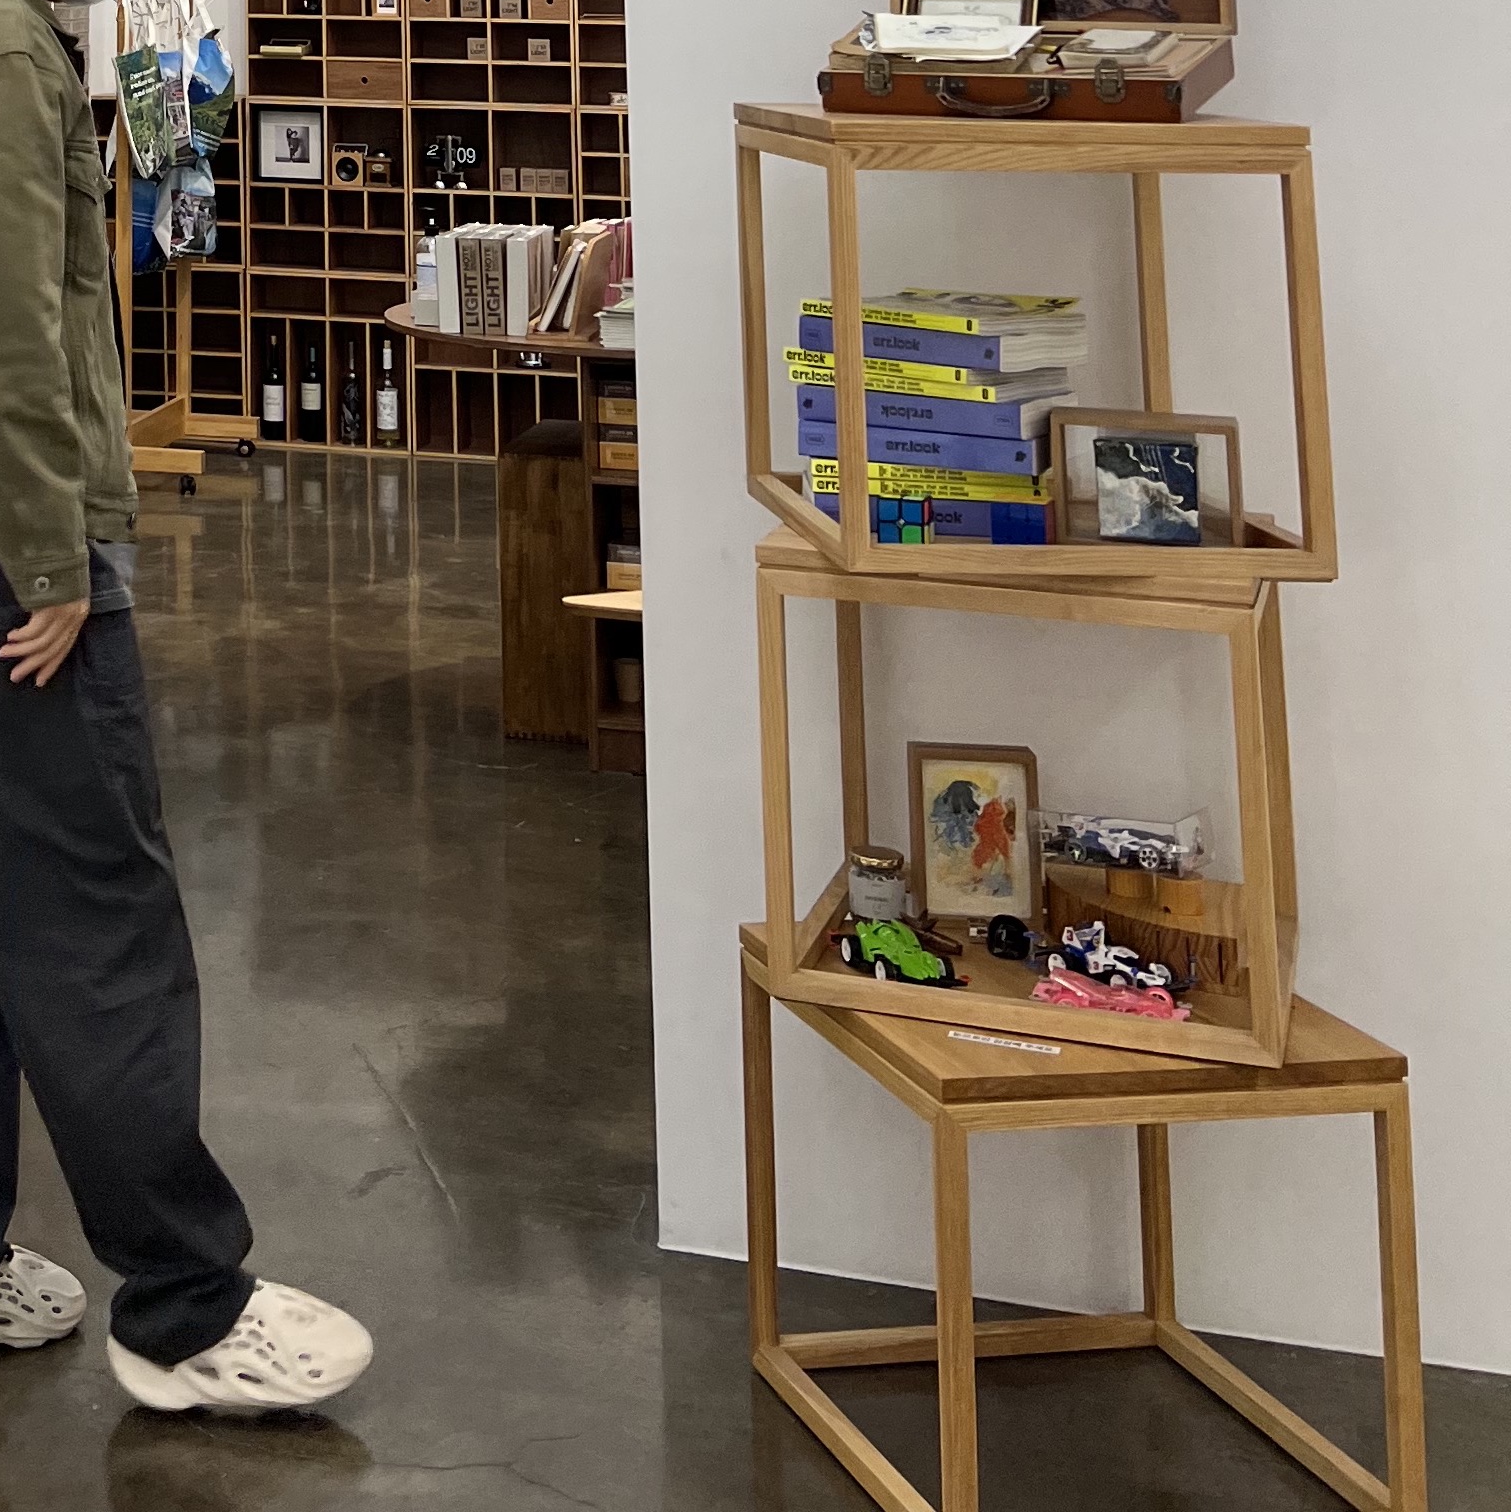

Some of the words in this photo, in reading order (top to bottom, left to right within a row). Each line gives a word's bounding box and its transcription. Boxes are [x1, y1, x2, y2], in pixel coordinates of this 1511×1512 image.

[456, 147, 476, 164] 09
[463, 245, 472, 271] NOTE
[484, 247, 494, 271] NOTE
[464, 273, 480, 328] LIGHT
[486, 273, 502, 329] LIGHT
[802, 302, 833, 315] err.lo
[786, 350, 826, 364] err.look
[885, 440, 941, 455] err.look
[814, 463, 839, 475] err.
[816, 479, 840, 491] err.
